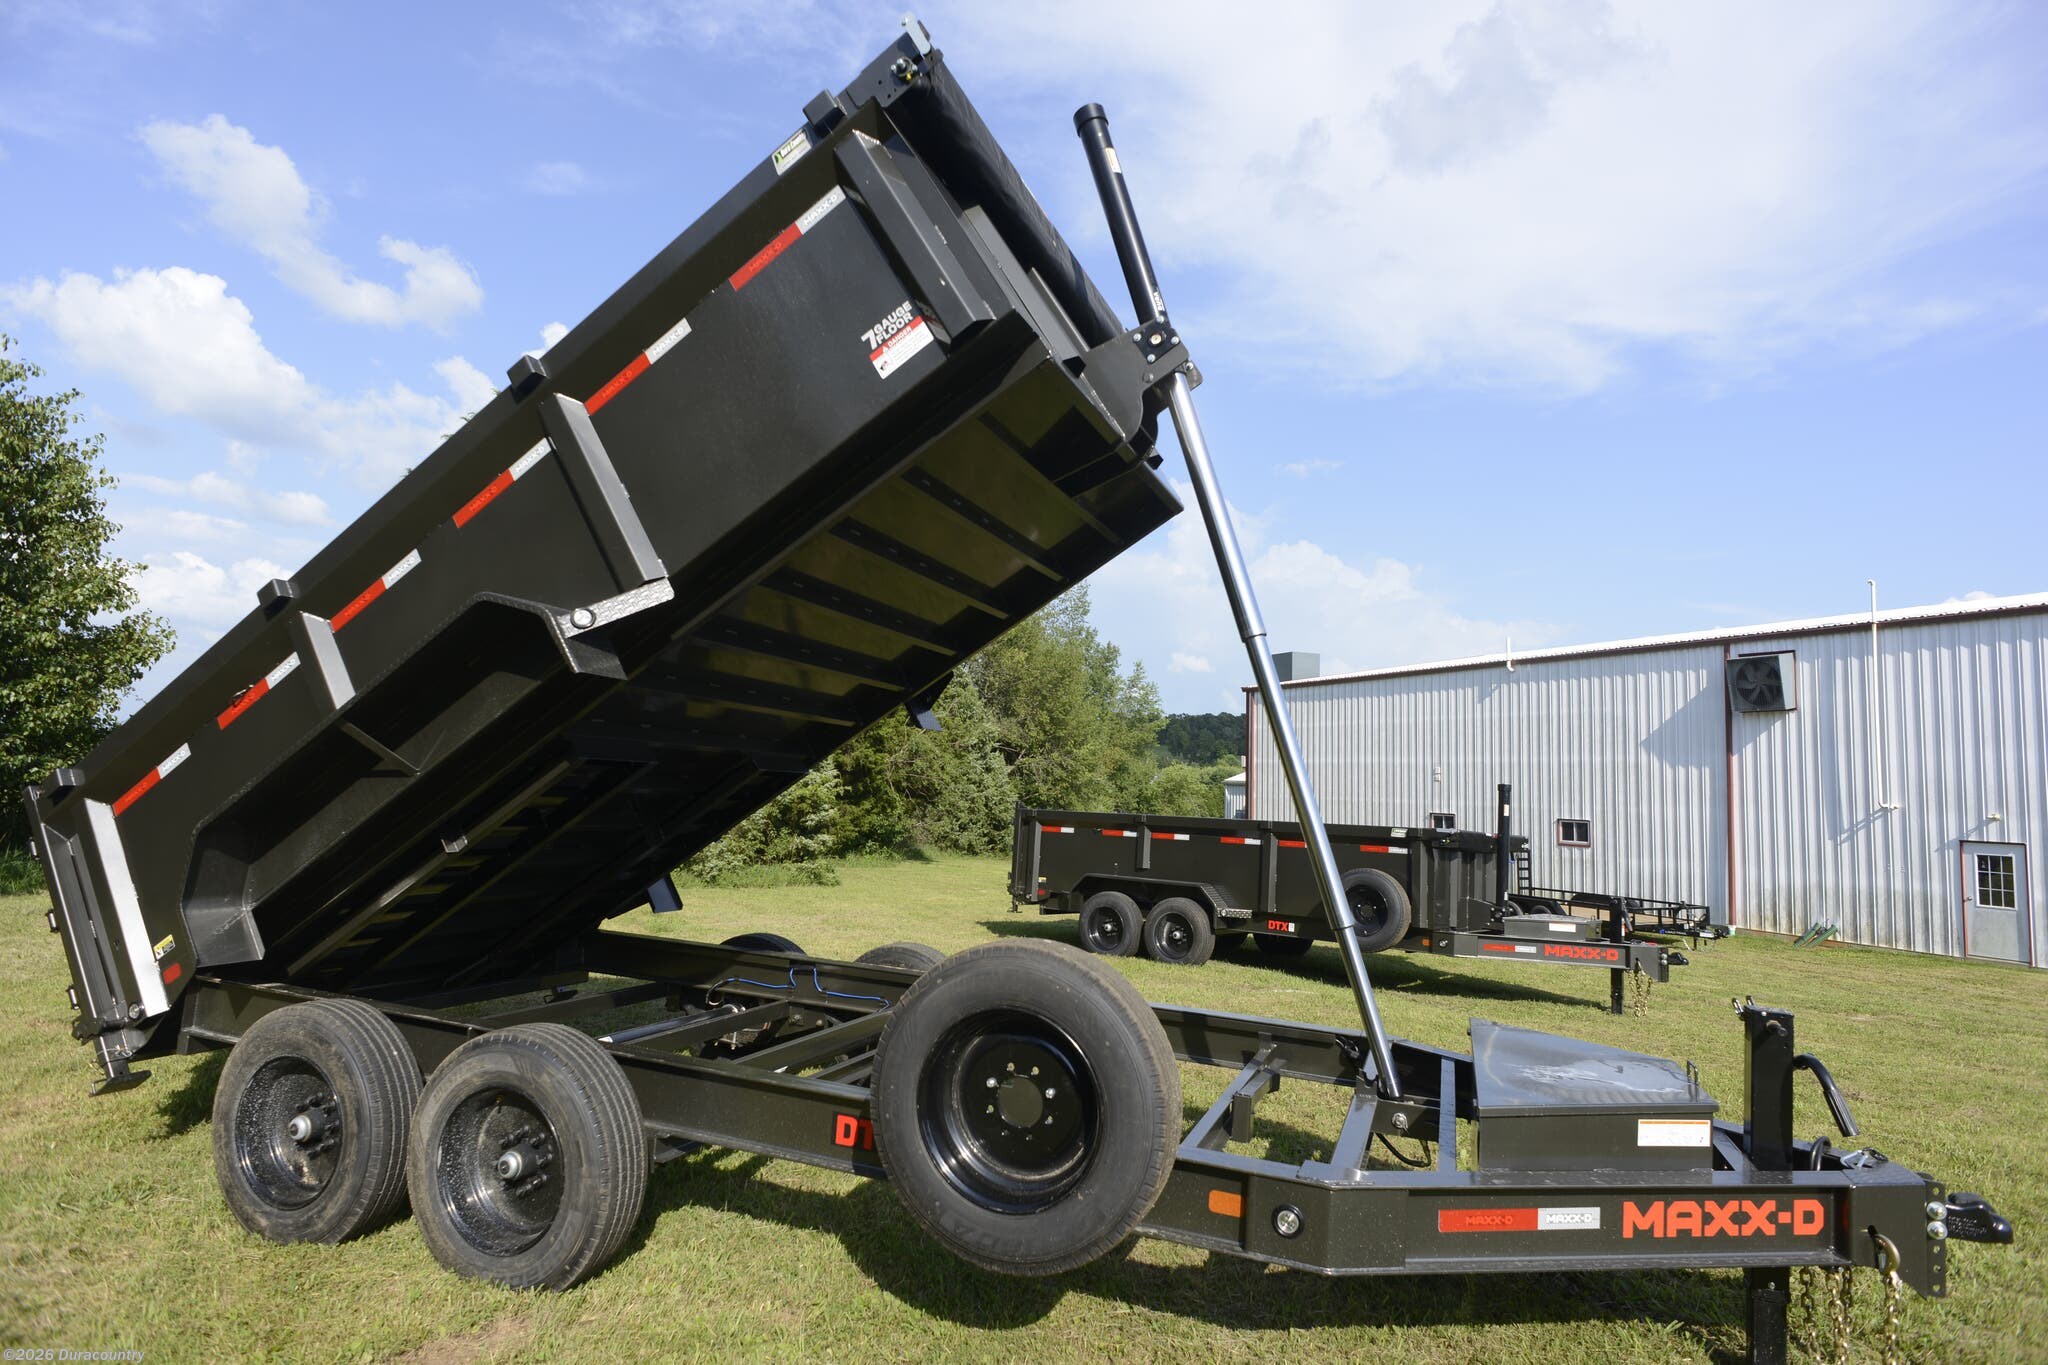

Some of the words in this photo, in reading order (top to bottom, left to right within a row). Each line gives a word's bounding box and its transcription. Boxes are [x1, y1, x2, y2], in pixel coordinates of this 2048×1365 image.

[803, 194, 838, 226] MAXX-D
[860, 328, 878, 350] 7
[874, 300, 912, 334] GAUGE
[875, 312, 913, 345] FLOOR
[1268, 919, 1288, 932] DTX
[1544, 943, 1619, 961] MAXX-D
[835, 1114, 873, 1151] DT
[1465, 1215, 1513, 1227] MAXX-D
[1545, 1212, 1593, 1224] MAXX-D
[1622, 1199, 1825, 1239] MAXX-D
